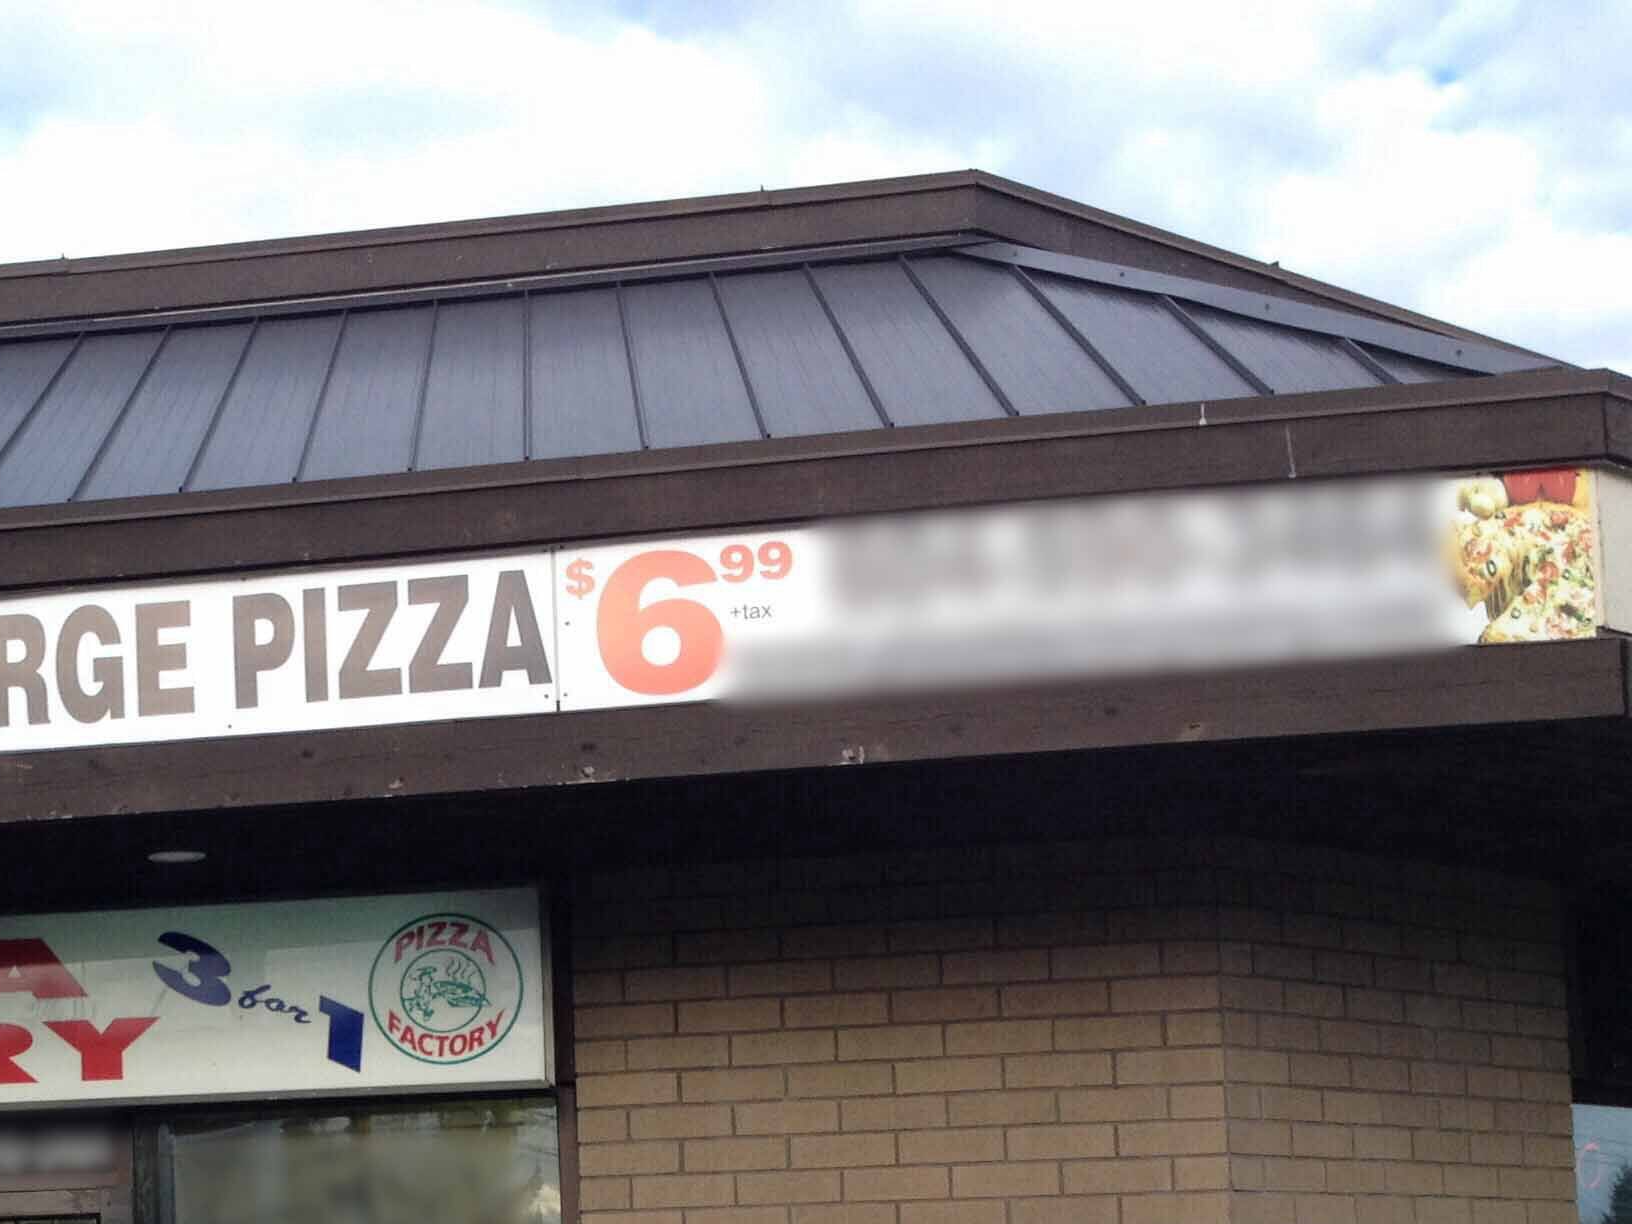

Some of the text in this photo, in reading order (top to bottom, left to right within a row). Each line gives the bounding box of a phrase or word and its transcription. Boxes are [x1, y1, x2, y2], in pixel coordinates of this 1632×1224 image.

[233, 569, 554, 709] PIZZA
[394, 921, 496, 964] PIZZA
[152, 930, 232, 1006] 3
[318, 994, 365, 1074] 1
[387, 1008, 505, 1058] FACTORY
